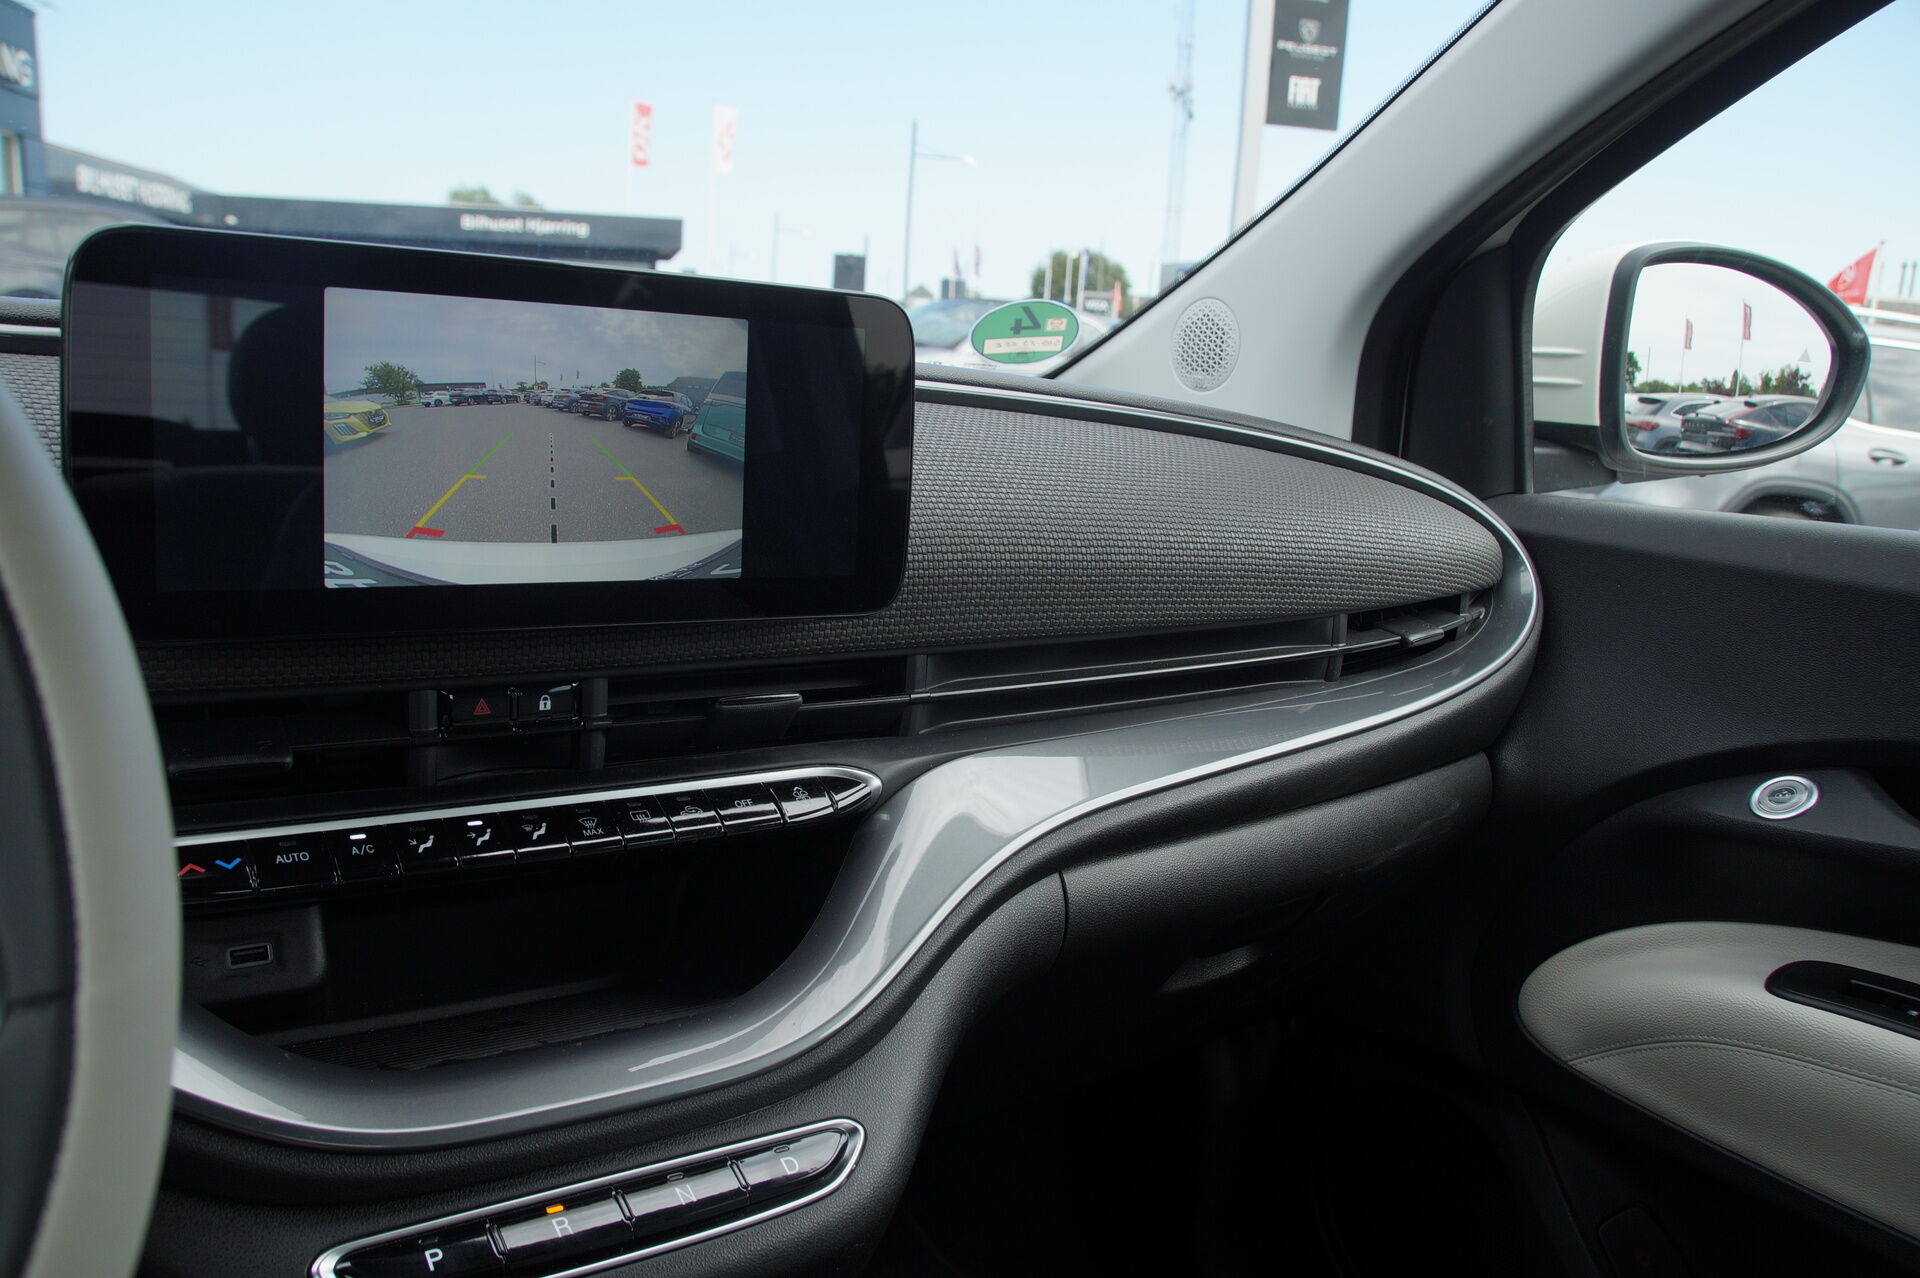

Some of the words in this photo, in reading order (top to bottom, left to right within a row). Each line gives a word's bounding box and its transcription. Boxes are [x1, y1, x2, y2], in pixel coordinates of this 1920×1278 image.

[1276, 40, 1338, 57] PEUGEOT
[1287, 74, 1322, 105] FIAT
[460, 213, 523, 233] Bilhuset
[734, 798, 753, 808] OFF
[583, 828, 604, 837] MAX
[275, 851, 310, 865] AUTO
[351, 843, 375, 856] A/C
[780, 1156, 799, 1175] D
[674, 1183, 697, 1205] N
[551, 1216, 574, 1238] R
[424, 1248, 443, 1272] P
